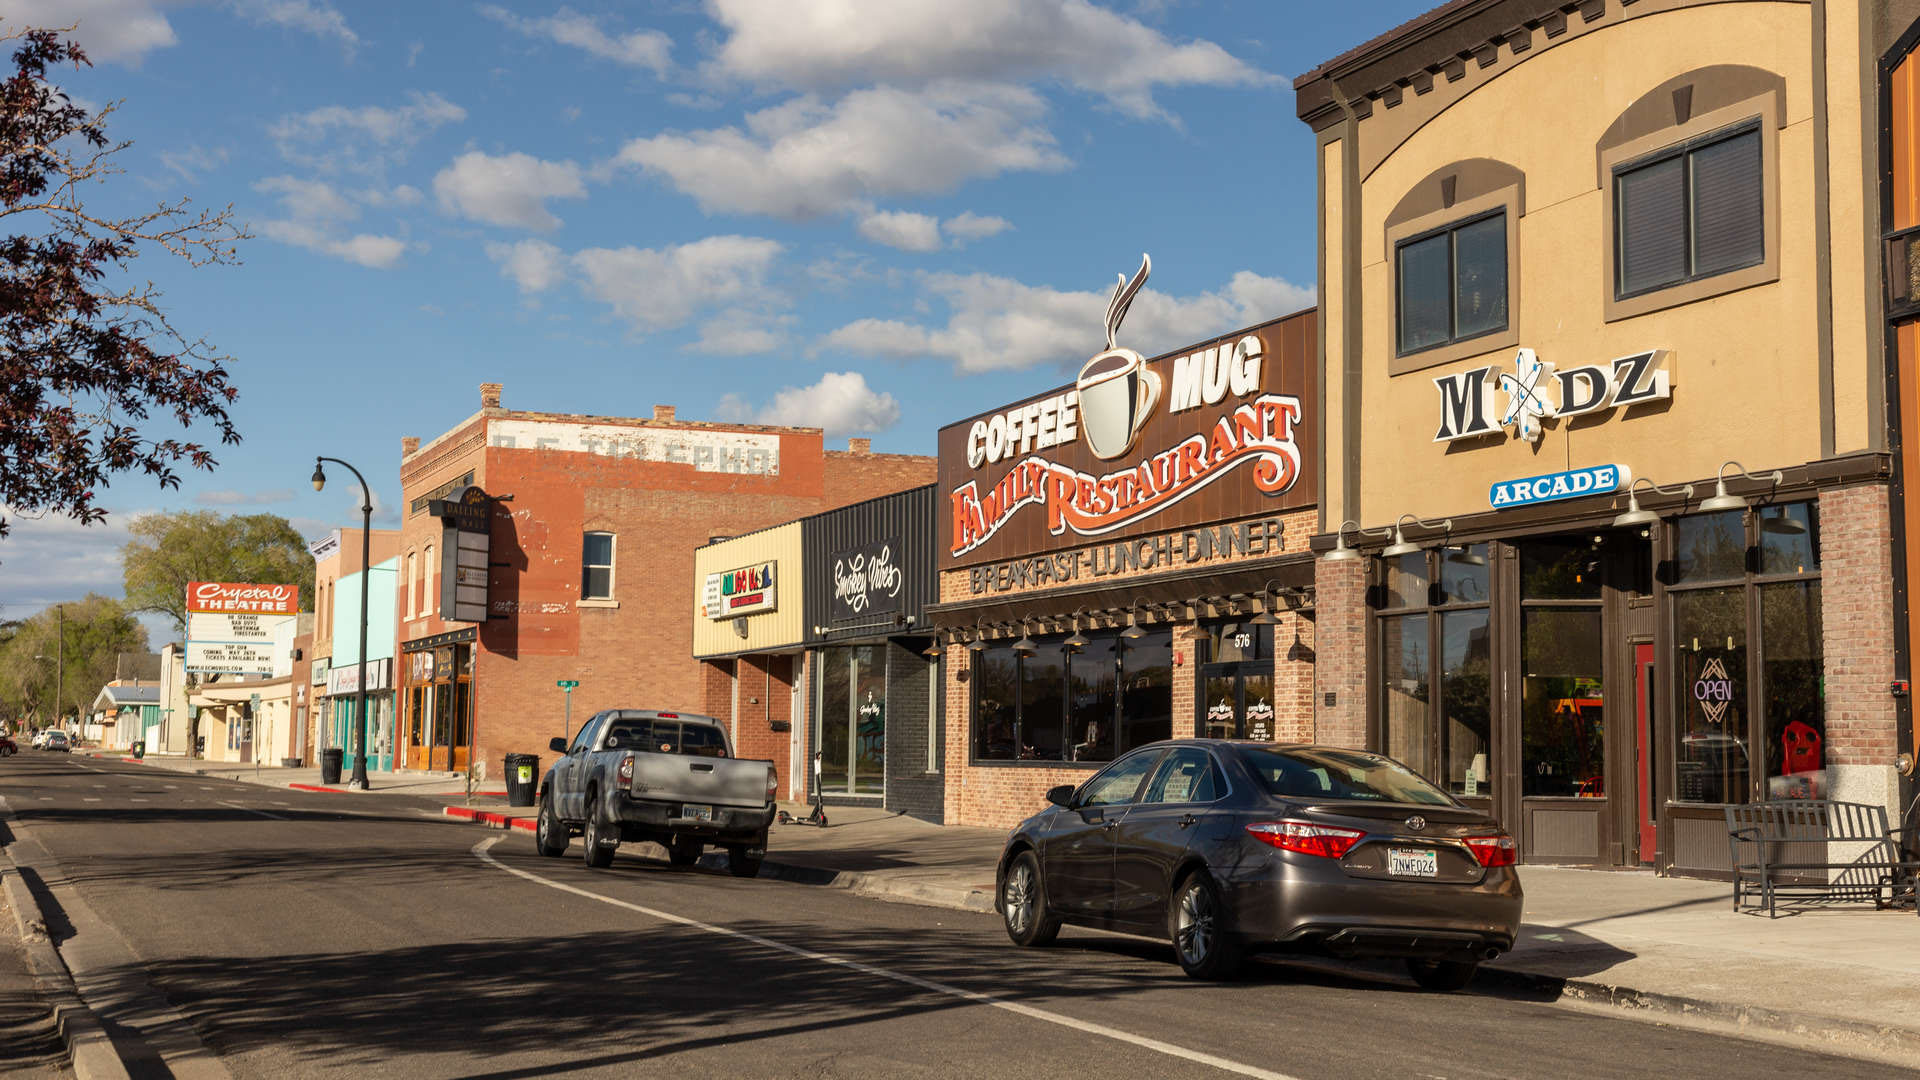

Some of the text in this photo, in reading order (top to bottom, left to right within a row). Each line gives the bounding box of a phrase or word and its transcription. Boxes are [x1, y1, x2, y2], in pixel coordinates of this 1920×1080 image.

[967, 335, 1263, 470] COFFEE MUG
[950, 393, 1302, 558] FAMILY RESTAURANT
[1492, 467, 1616, 507] ARCADE
[722, 569, 747, 596] AMIGO
[835, 545, 902, 613] Smokey Vibes
[196, 583, 291, 604] Crystal
[196, 599, 288, 611] THEATRE
[1234, 633, 1250, 648] 576
[1694, 680, 1732, 700] OPEN
